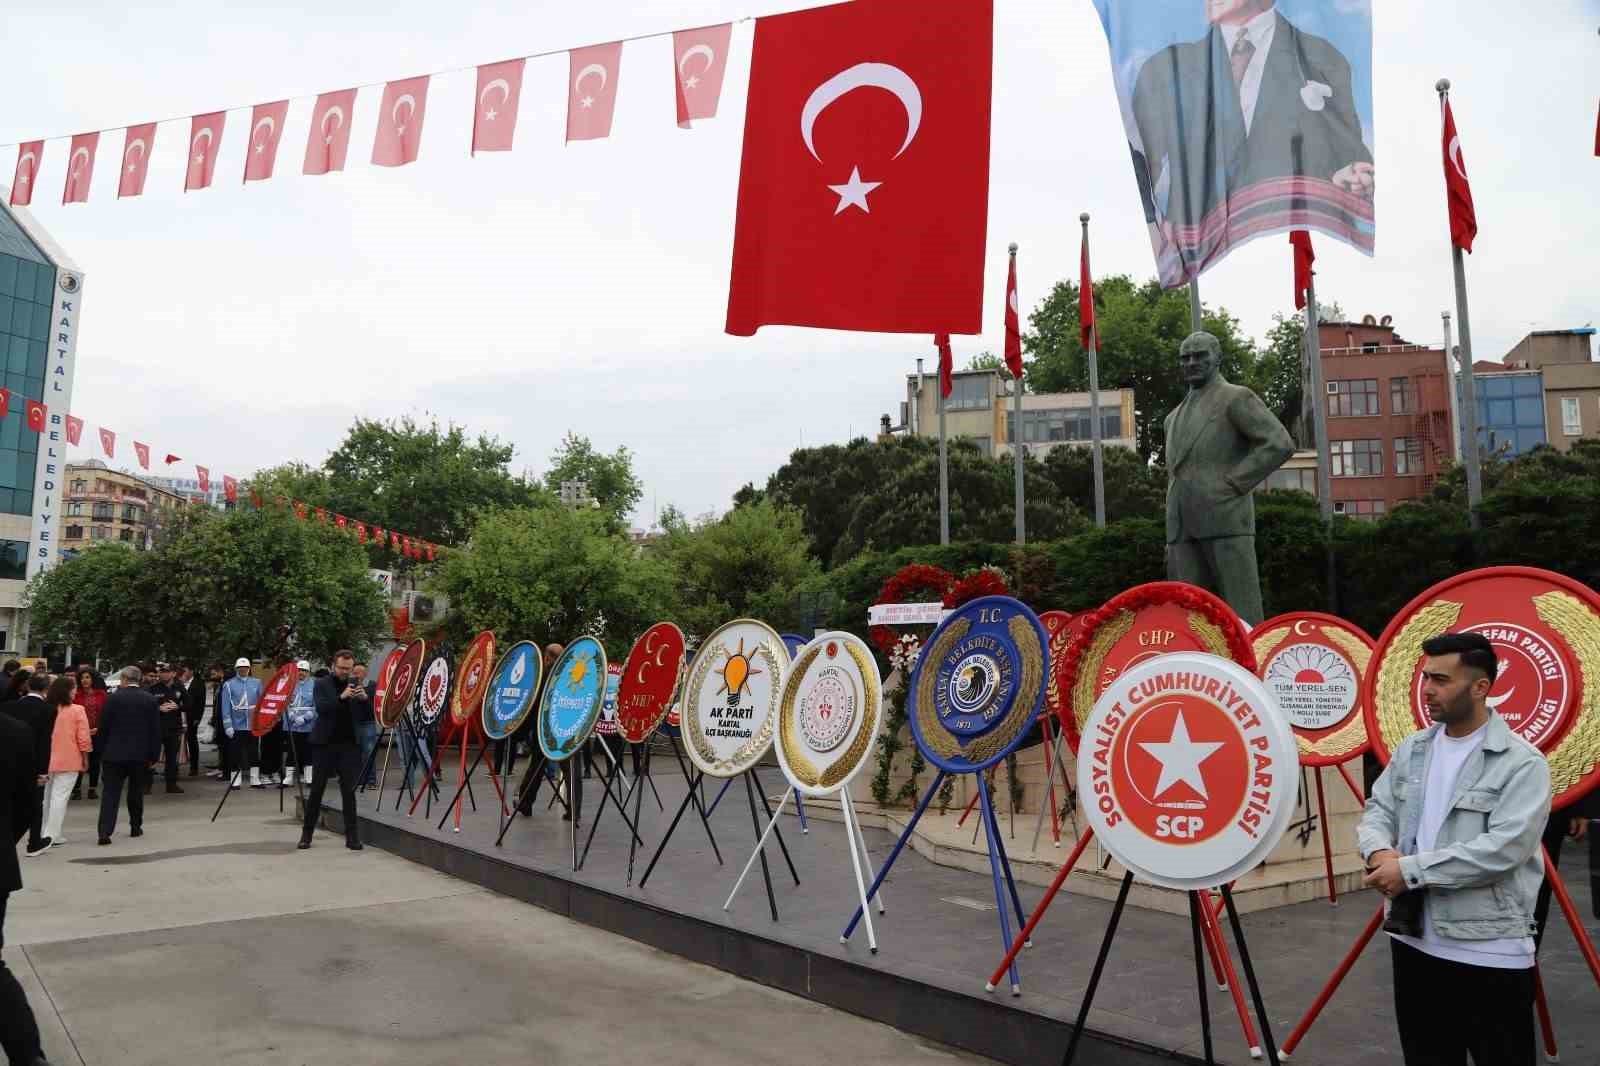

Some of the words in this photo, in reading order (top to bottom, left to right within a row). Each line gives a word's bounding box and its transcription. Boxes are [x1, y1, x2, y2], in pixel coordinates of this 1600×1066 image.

[53, 301, 73, 391] KARTAL
[1138, 630, 1175, 646] CHP
[1481, 629, 1519, 643] EFAH
[1520, 637, 1562, 680] PARTİSİ
[1296, 684, 1347, 692] YEREL-SEN
[710, 706, 724, 718] AK
[725, 705, 754, 720] PARTİ
[1500, 712, 1522, 721] FAH
[1523, 699, 1558, 741] ANLIĞI
[718, 719, 740, 728] KARTAL
[1092, 702, 1128, 828] SOSYALİST
[1127, 671, 1262, 731] CUMHURİYET
[1237, 735, 1273, 839] PARTİSİ
[1155, 815, 1205, 838] SCP
